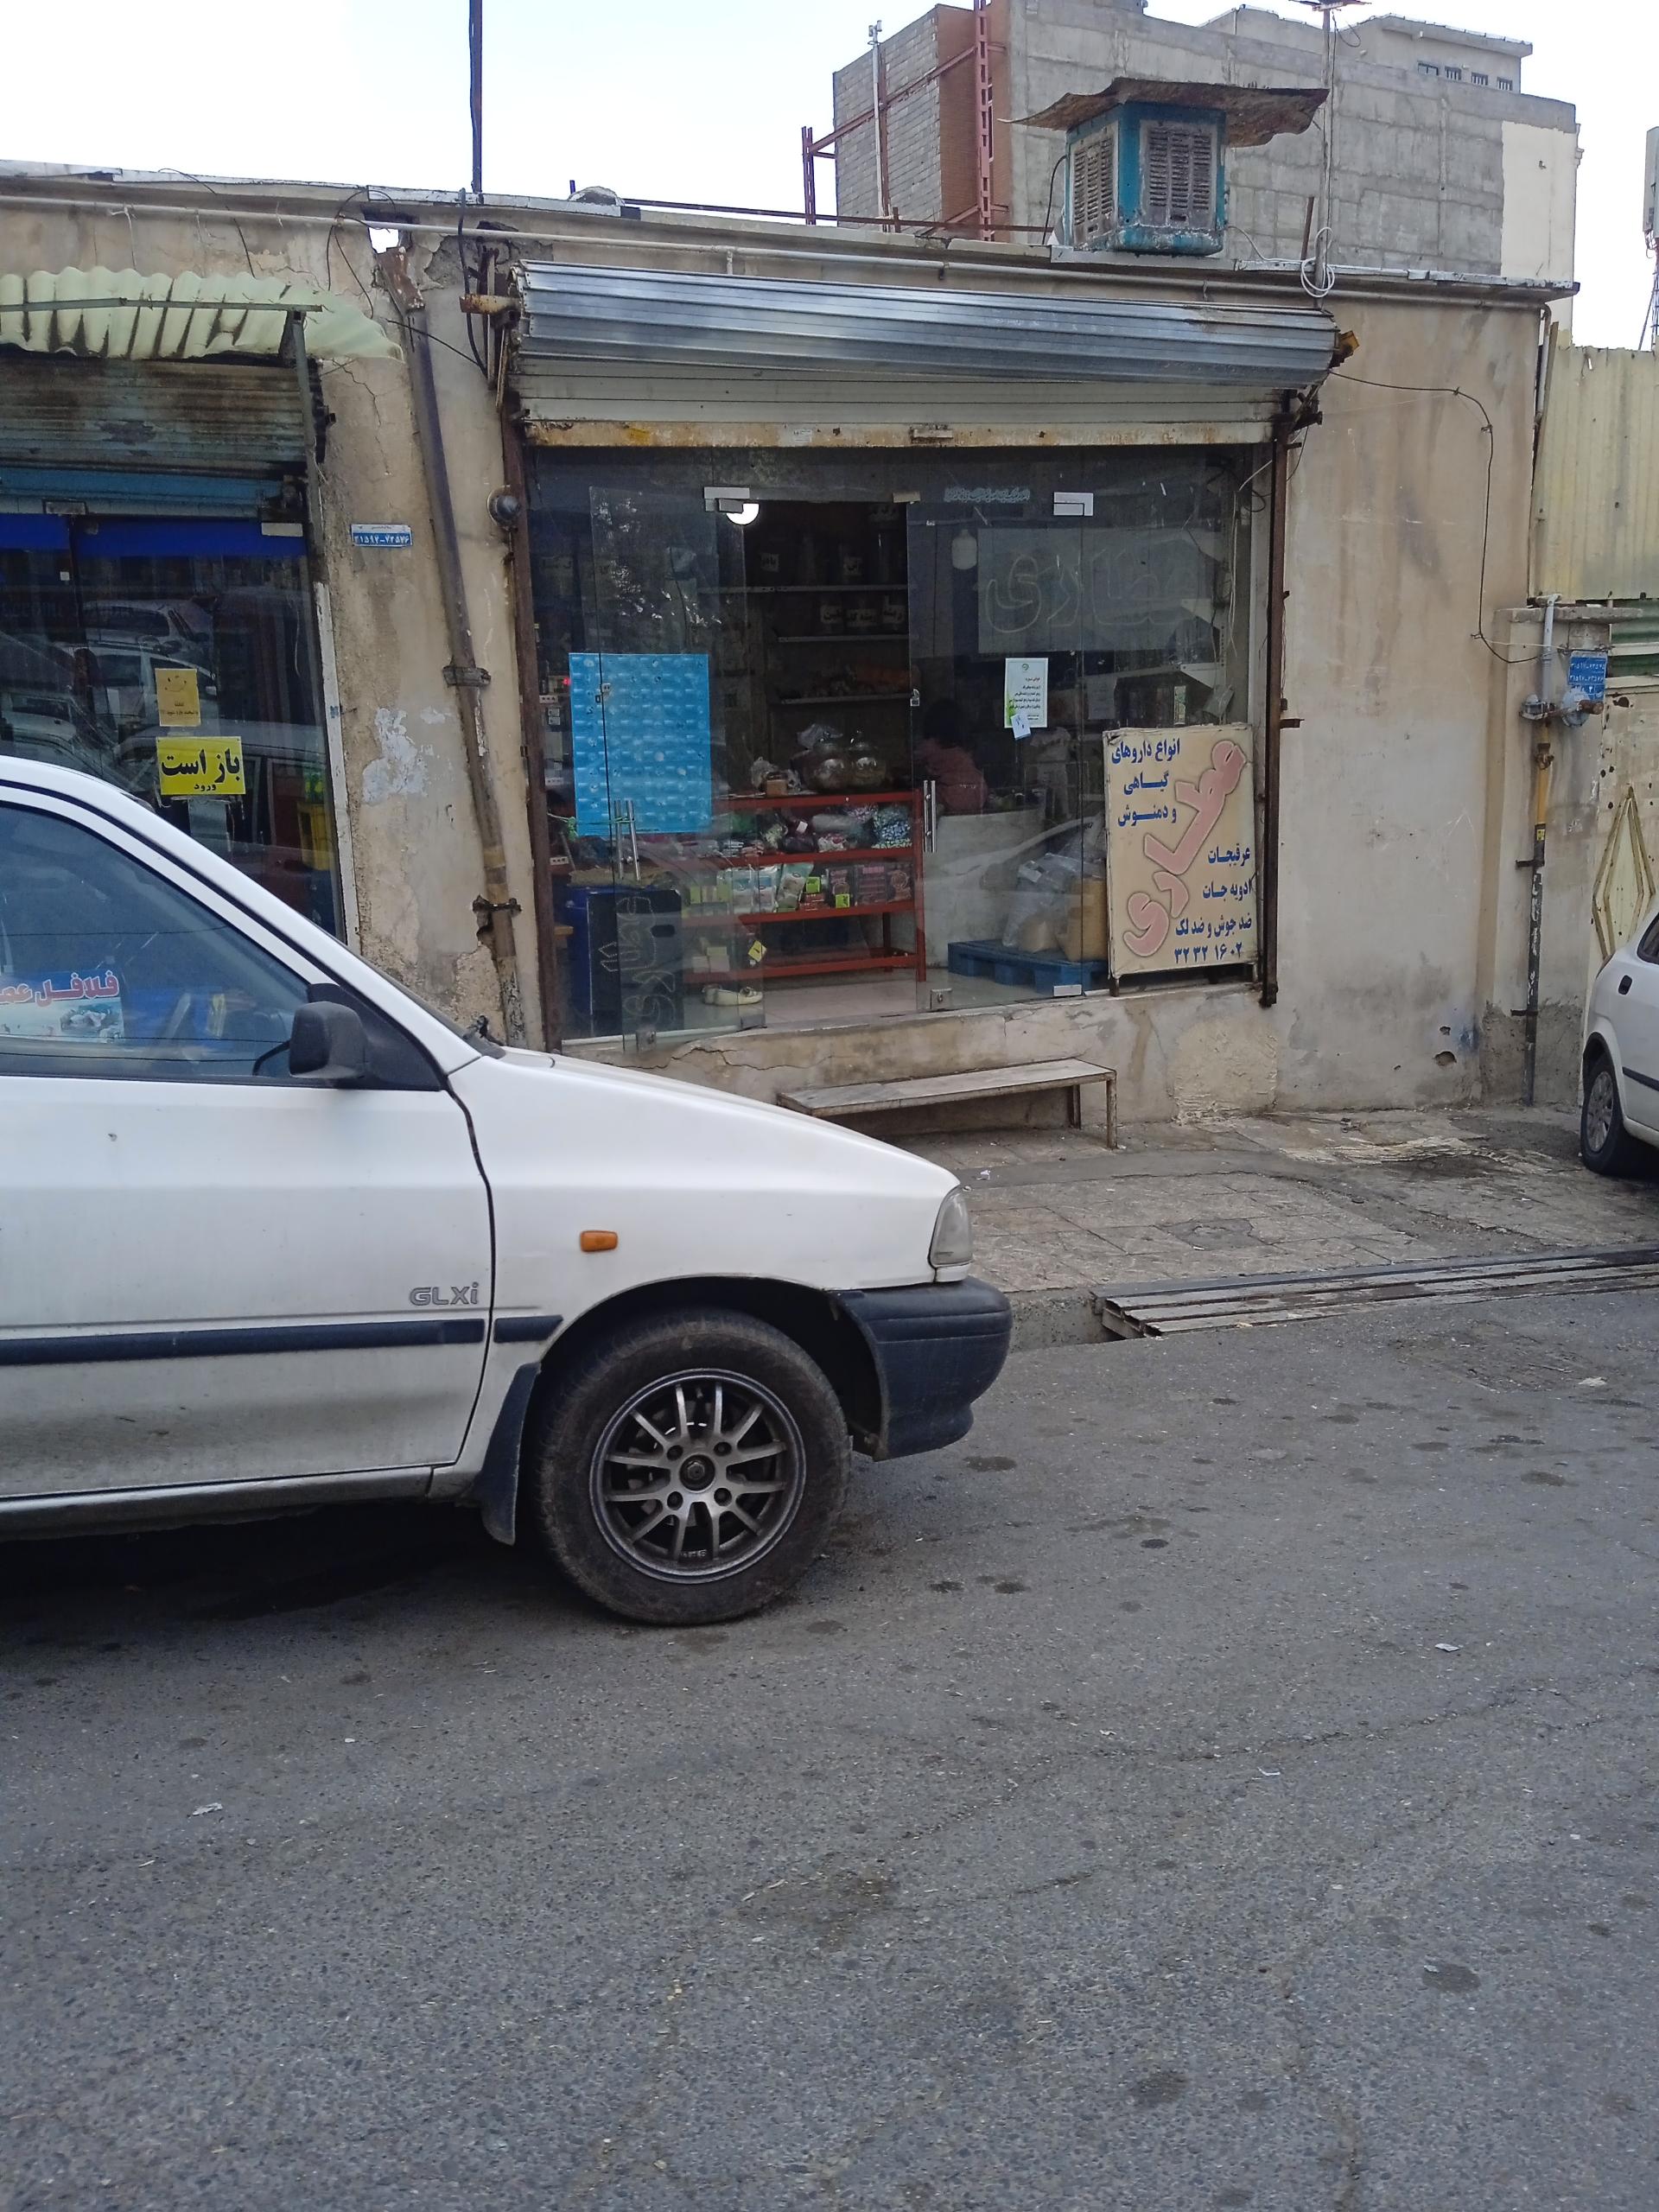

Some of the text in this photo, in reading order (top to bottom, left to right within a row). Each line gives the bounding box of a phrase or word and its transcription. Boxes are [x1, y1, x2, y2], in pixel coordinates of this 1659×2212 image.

[1111, 738, 1180, 764] انواع داروهای
[161, 748, 240, 783] باز است
[1124, 771, 1169, 795] گیاهی
[1117, 804, 1177, 827] و دمنوش
[1123, 740, 1247, 957] عطاری
[1208, 843, 1250, 867] عرقیجات
[1203, 879, 1252, 901] ادویه جات
[1175, 912, 1252, 938] ضد جوش و ضد لک
[35, 969, 119, 1007] فلافل
[410, 1281, 479, 1306] GLXi
